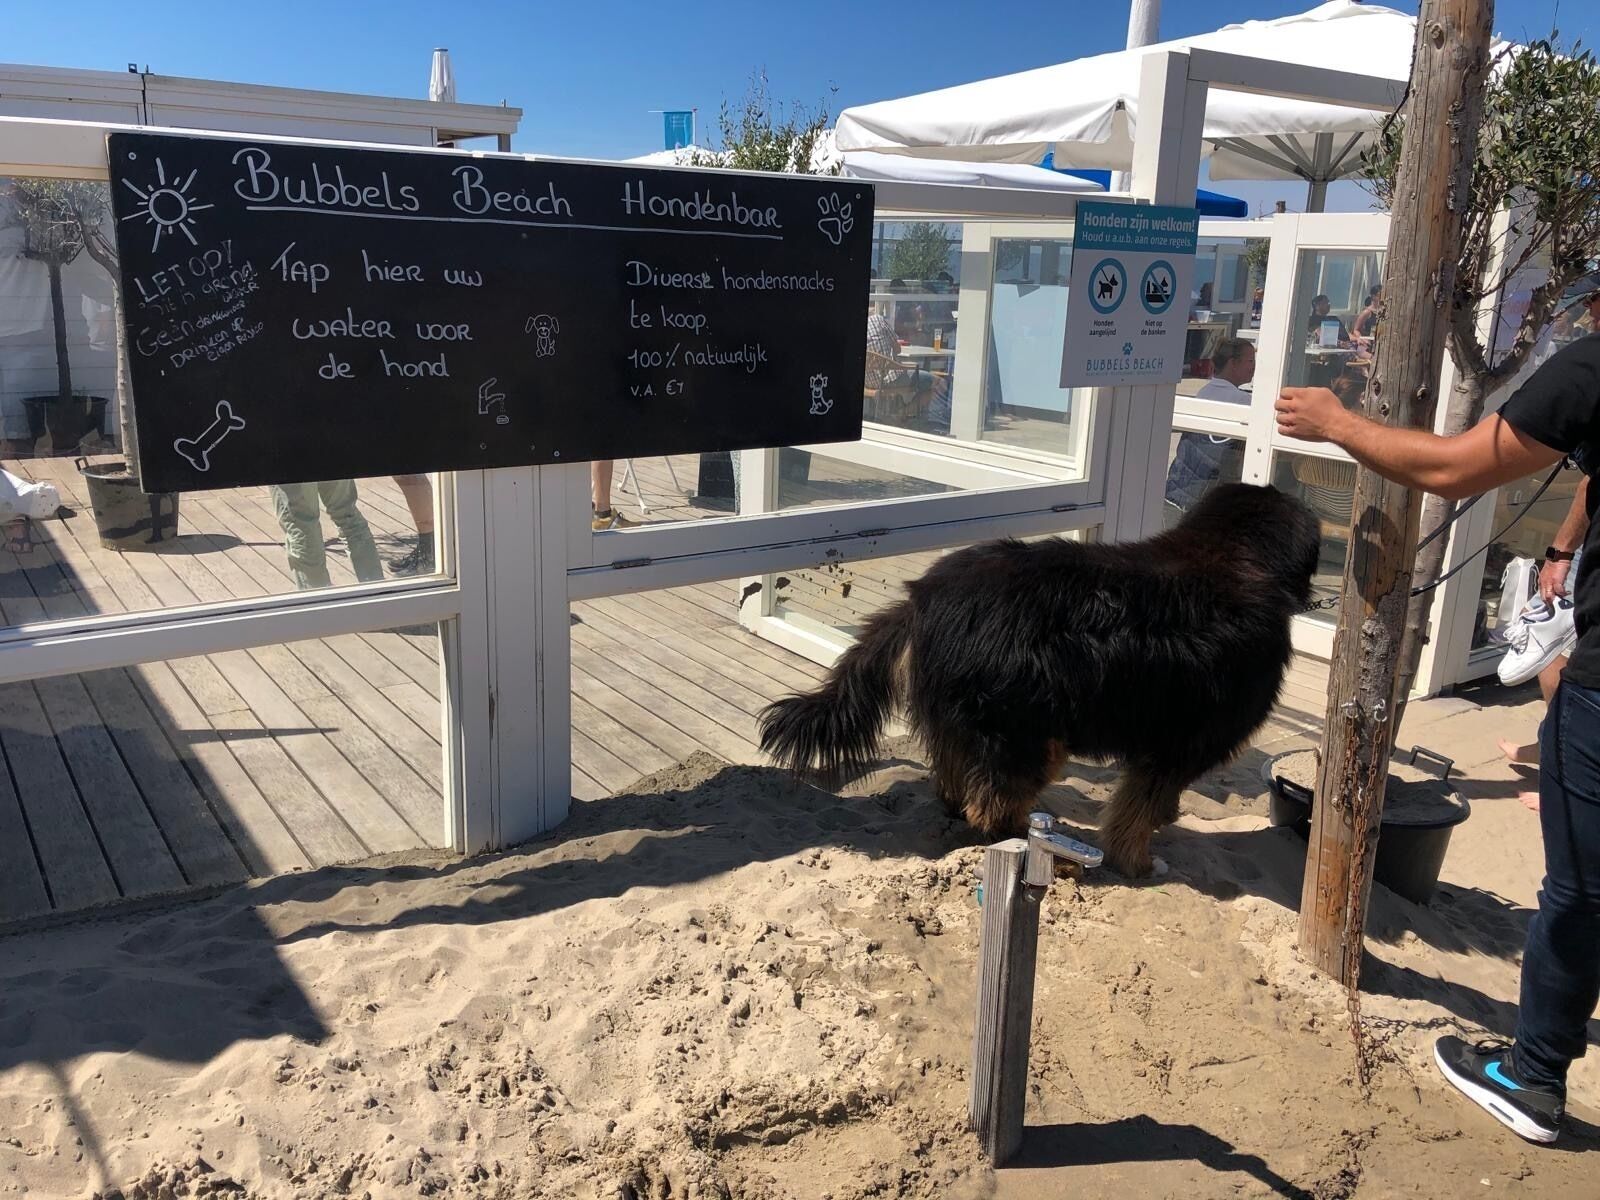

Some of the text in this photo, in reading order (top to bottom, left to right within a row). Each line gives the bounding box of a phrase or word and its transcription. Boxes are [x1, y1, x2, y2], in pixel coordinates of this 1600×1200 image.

[232, 147, 783, 229] Bubbels Beach Hondenbar
[1083, 211, 1196, 233] Honden zijn welkom!
[1081, 231, 1193, 249] Houd u a.u.b. aan onze regels.
[134, 239, 233, 303] LET OP!
[362, 249, 424, 283] hier
[444, 268, 483, 287] uw
[625, 260, 835, 292] Diverse hondensnacks
[292, 306, 473, 341] water voor
[630, 299, 652, 329] te
[1093, 319, 1114, 327] Honden
[1156, 320, 1163, 328] op
[1140, 328, 1147, 336] de
[318, 349, 450, 380] de hond
[627, 343, 768, 374] 100% natuurlijk
[1086, 357, 1164, 371] BUBBELS BEACH
